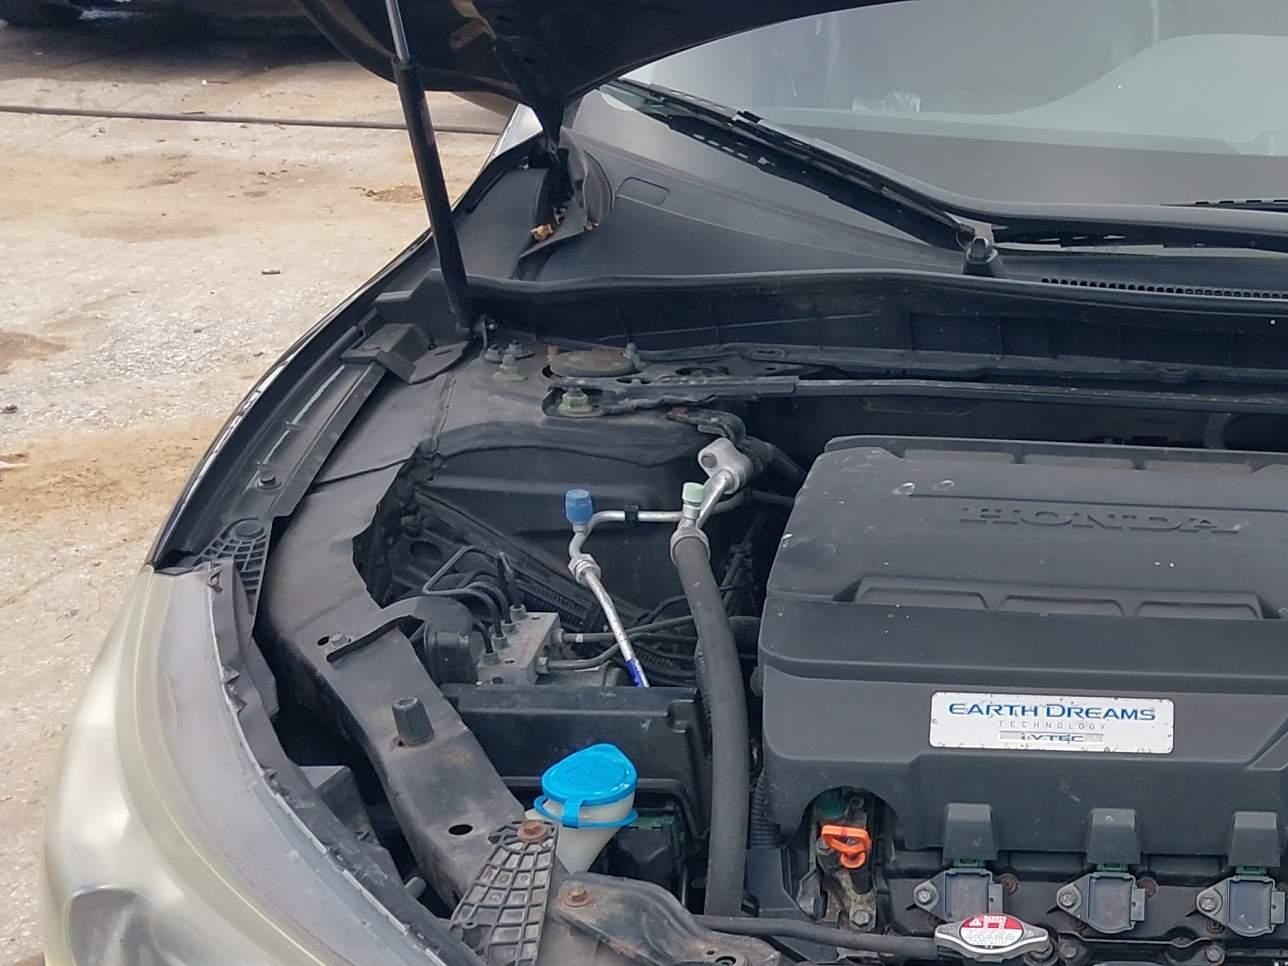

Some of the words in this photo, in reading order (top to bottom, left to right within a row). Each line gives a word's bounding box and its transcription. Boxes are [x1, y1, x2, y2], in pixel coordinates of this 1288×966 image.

[960, 507, 1240, 533] HONDA
[948, 703, 1038, 718] EARTH
[999, 720, 1106, 730] TECHNOLOGY
